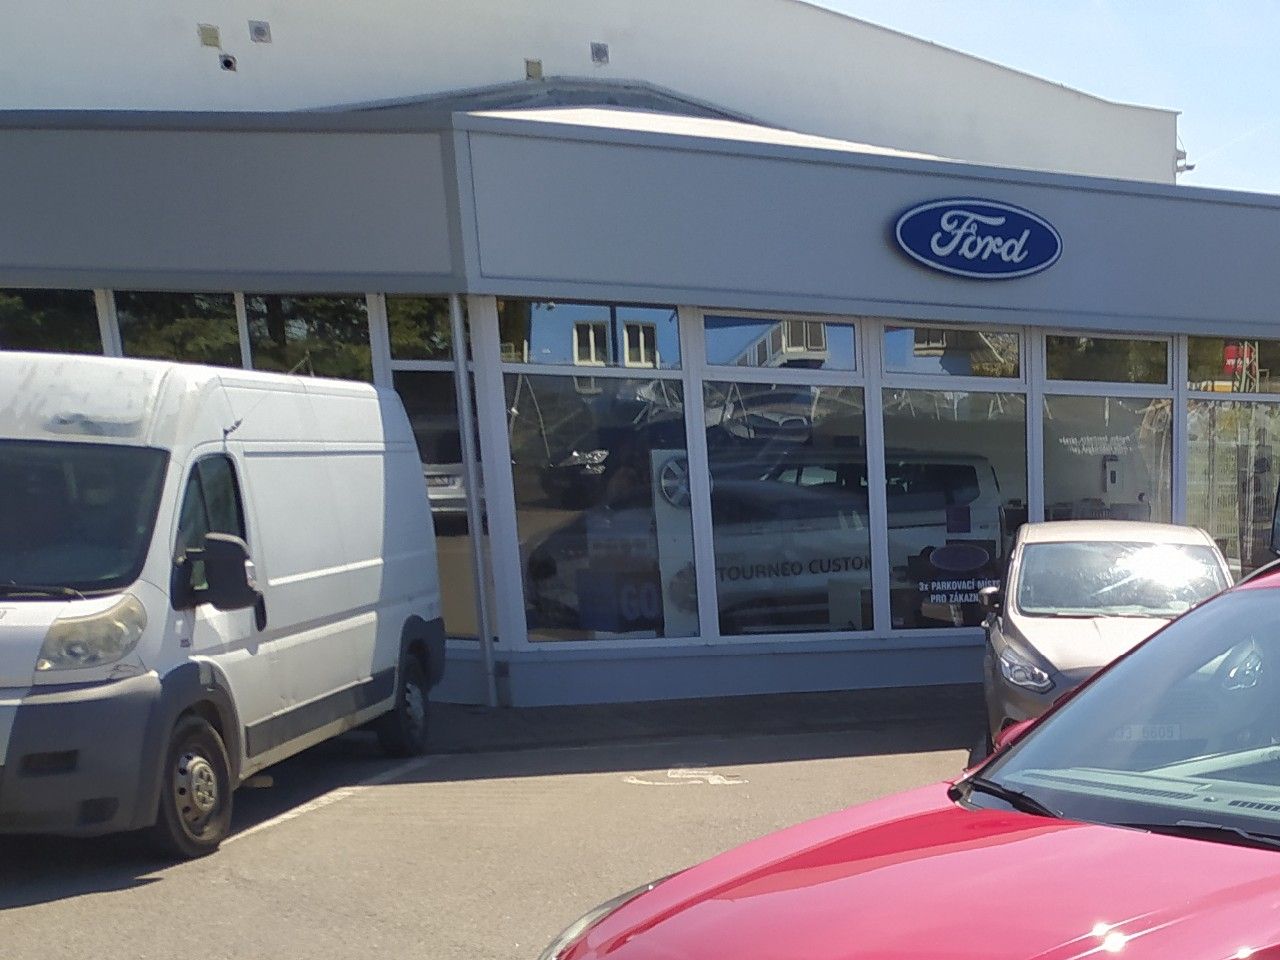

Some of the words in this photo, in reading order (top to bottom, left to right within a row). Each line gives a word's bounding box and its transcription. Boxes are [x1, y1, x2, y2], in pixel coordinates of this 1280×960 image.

[930, 209, 1031, 263] Ford
[716, 562, 804, 582] TOURNEO
[932, 579, 975, 591] PARKOVACÍ
[931, 594, 947, 603] PRO
[949, 592, 980, 603] ZÁKAZN
